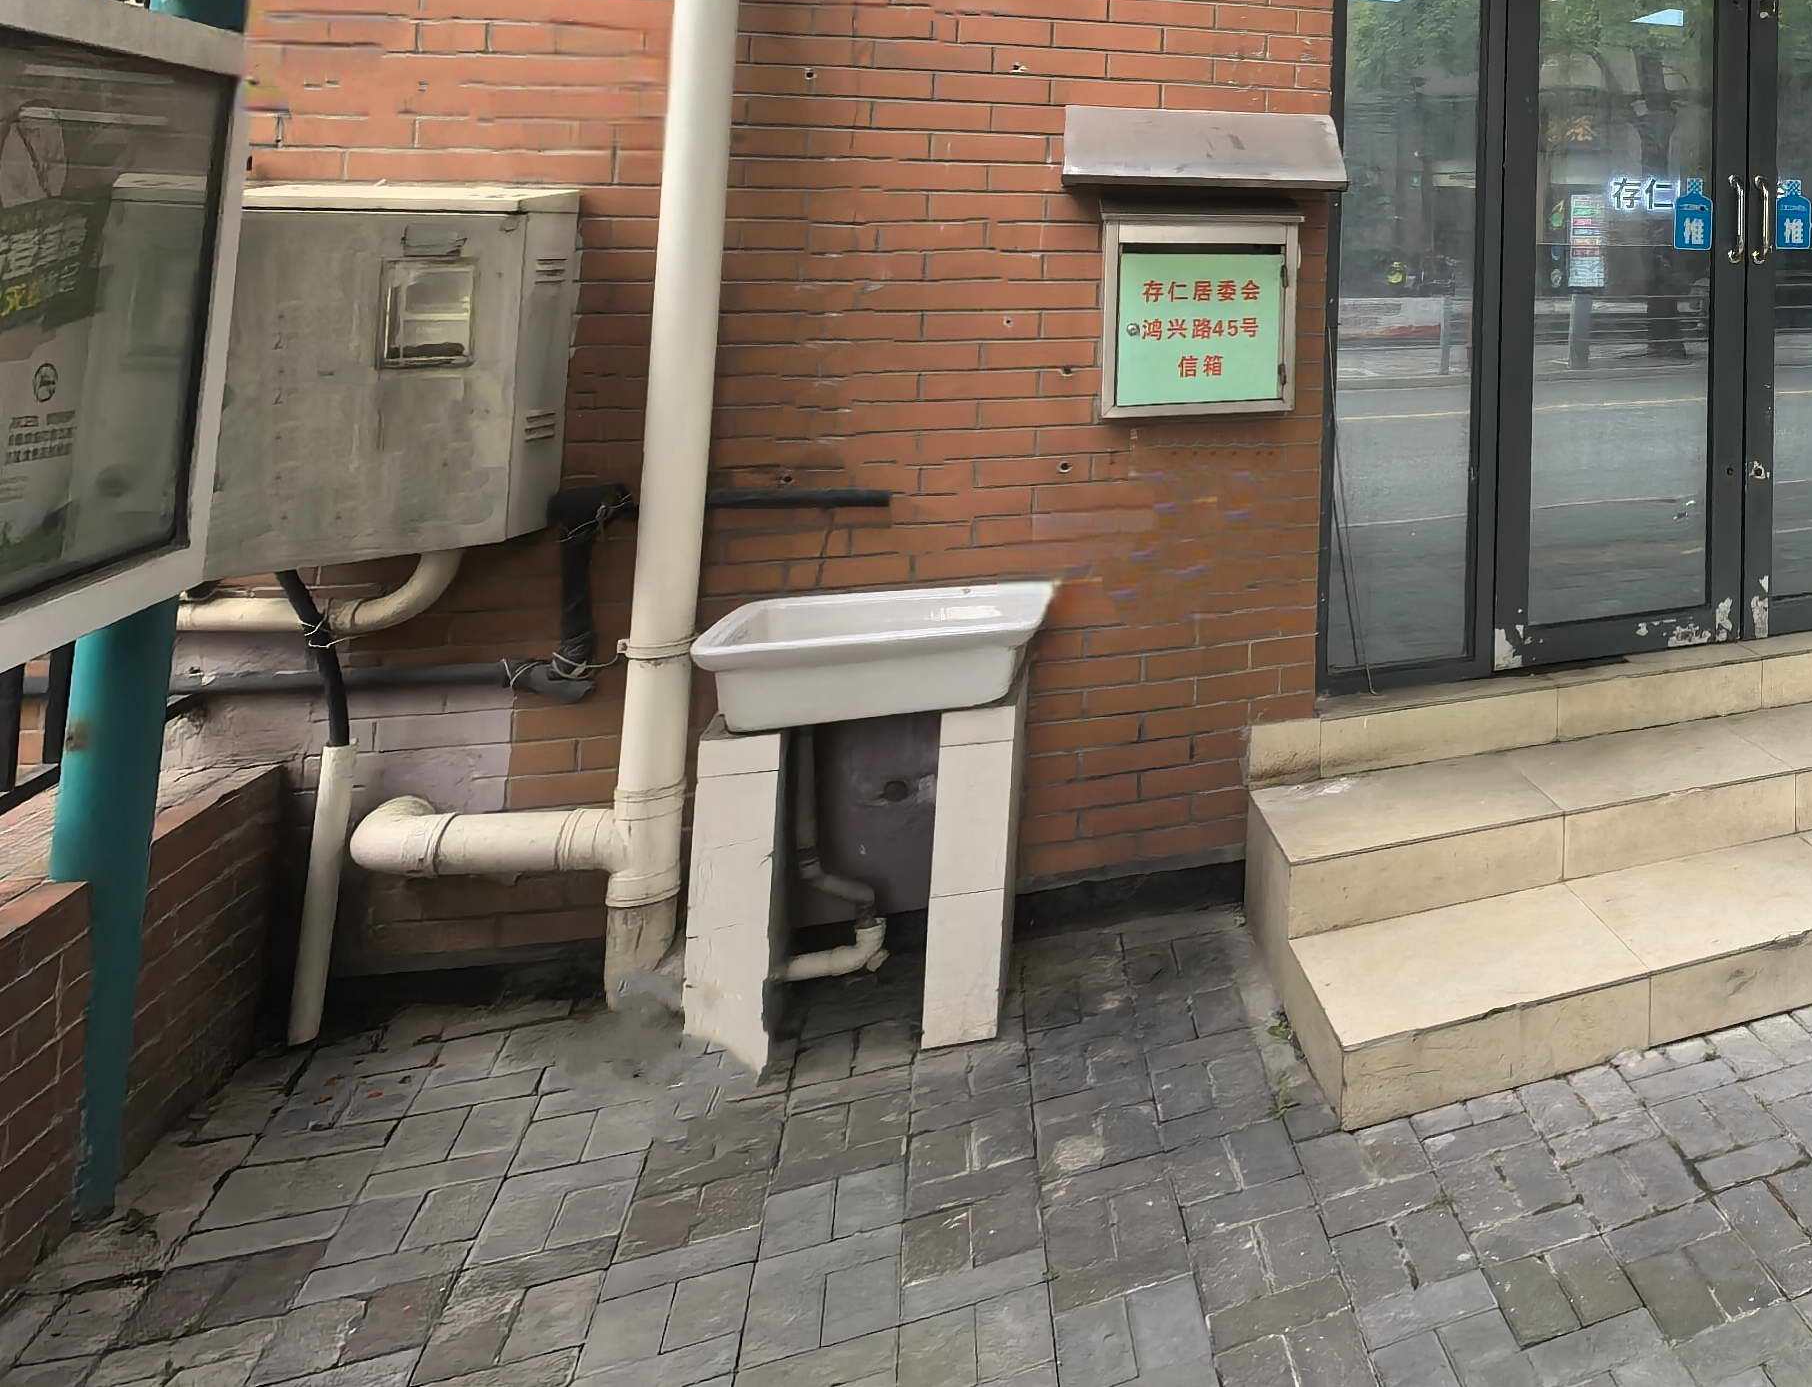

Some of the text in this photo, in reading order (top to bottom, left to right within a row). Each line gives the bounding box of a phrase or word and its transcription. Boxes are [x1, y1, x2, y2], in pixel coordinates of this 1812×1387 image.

[1142, 280, 1261, 303] 存仁居委会
[1141, 317, 1260, 341] 鸿兴路45号
[1178, 355, 1225, 378] 信箱
